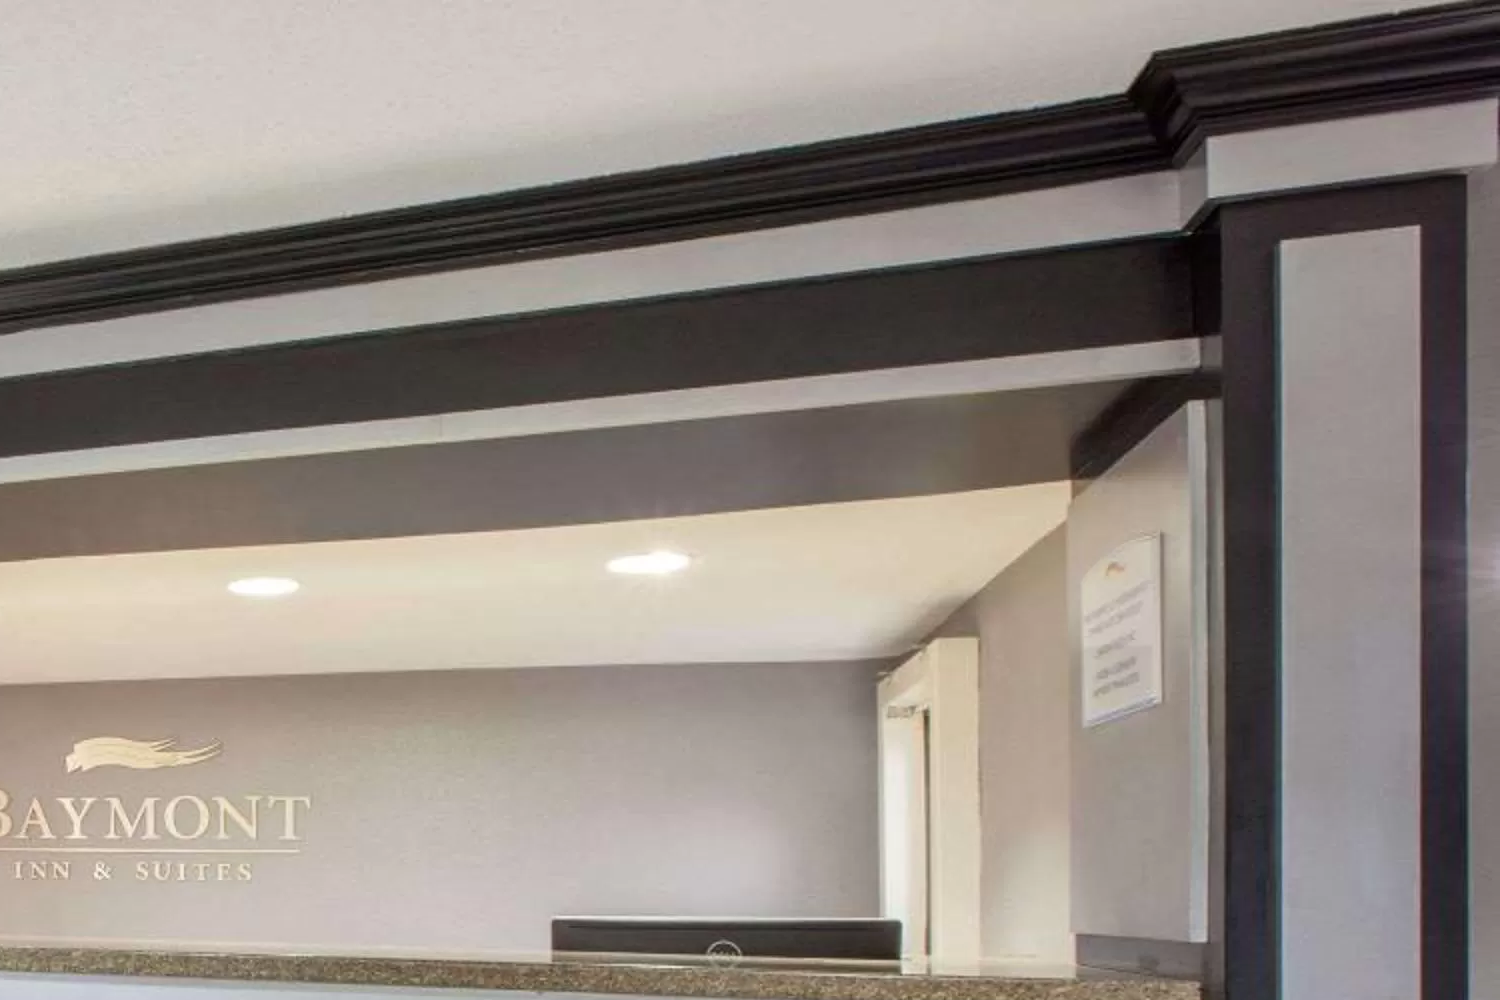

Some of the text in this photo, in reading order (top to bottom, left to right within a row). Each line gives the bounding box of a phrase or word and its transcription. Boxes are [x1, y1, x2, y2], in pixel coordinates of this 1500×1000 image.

[13, 860, 253, 881] INN & SUITES
